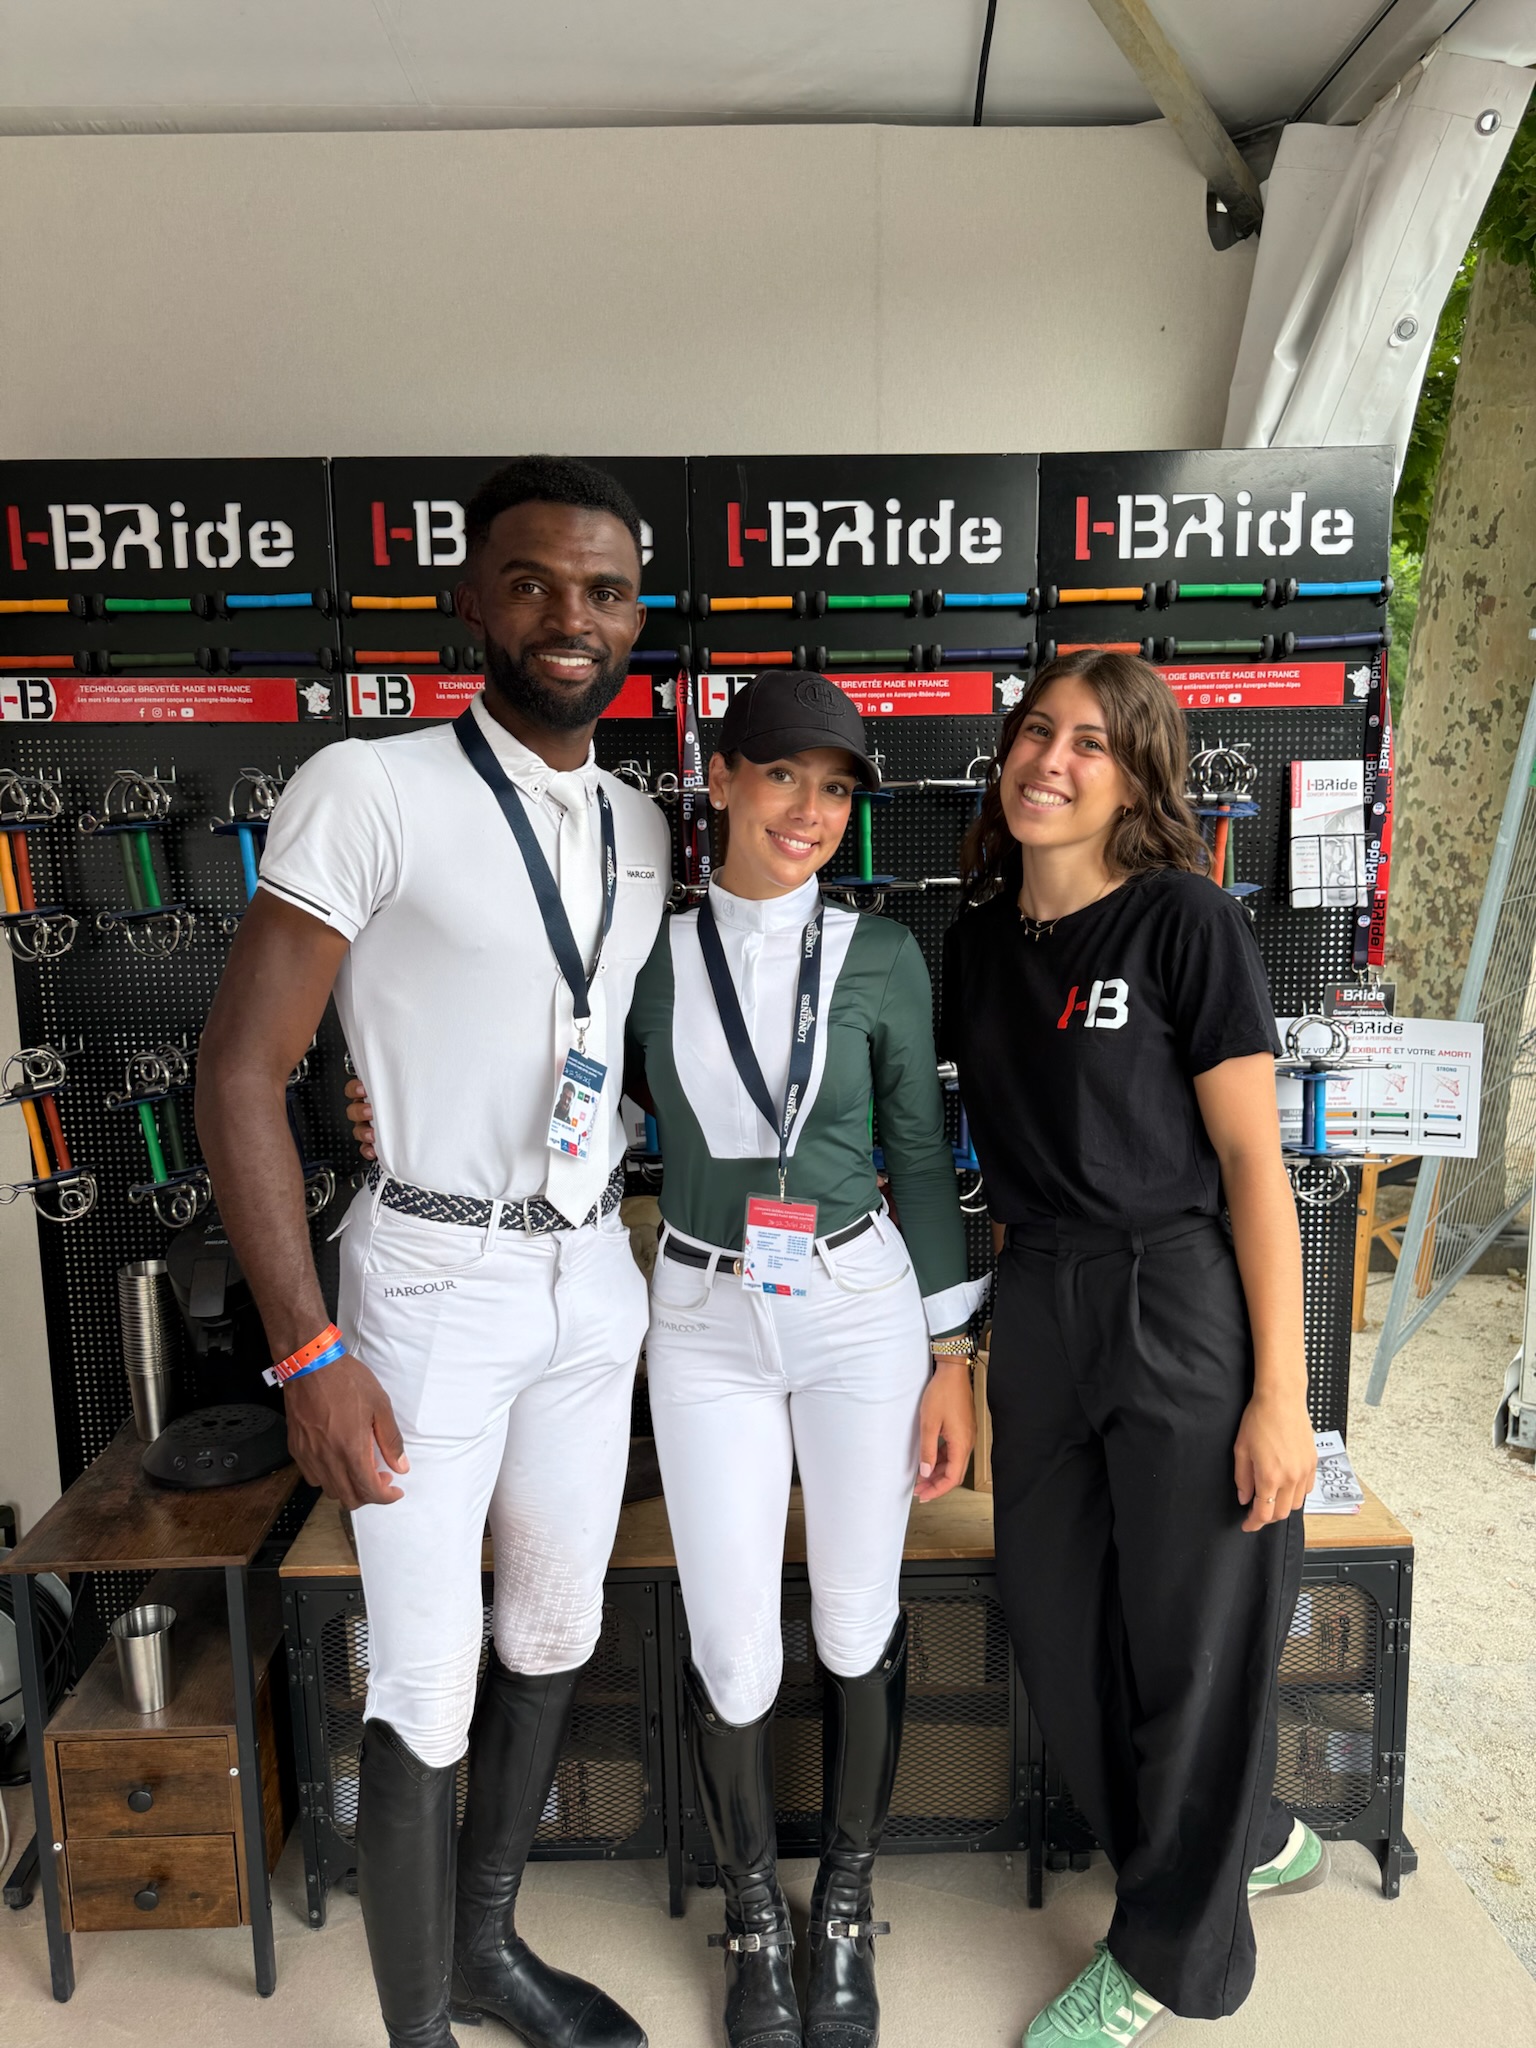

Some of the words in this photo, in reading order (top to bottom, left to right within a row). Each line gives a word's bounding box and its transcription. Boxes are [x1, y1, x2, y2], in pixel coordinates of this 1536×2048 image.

[1188, 670, 1230, 680] BREVETÉE
[1232, 671, 1255, 679] MADE
[1257, 671, 1266, 679] IN
[1267, 670, 1300, 678] FRANCE
[79, 685, 136, 693] TECHNOLOGIE
[138, 683, 180, 693] BREVETÉE
[182, 685, 206, 693] MADE
[207, 685, 217, 693] IN
[218, 685, 251, 693] FRANCE
[841, 679, 882, 688] BREVETÉE
[883, 680, 906, 688] MADE
[907, 680, 916, 688] IN
[917, 680, 949, 688] FRANCE
[797, 994, 811, 1044] LONGINES
[1349, 1046, 1392, 1055] LEXIBILITÉ
[1407, 1048, 1436, 1057] VOTRE
[1438, 1050, 1472, 1059] AMORTI
[783, 1083, 800, 1138] LONGINES
[384, 1280, 458, 1298] HARCOUR
[658, 1318, 711, 1333] HARCOUR
